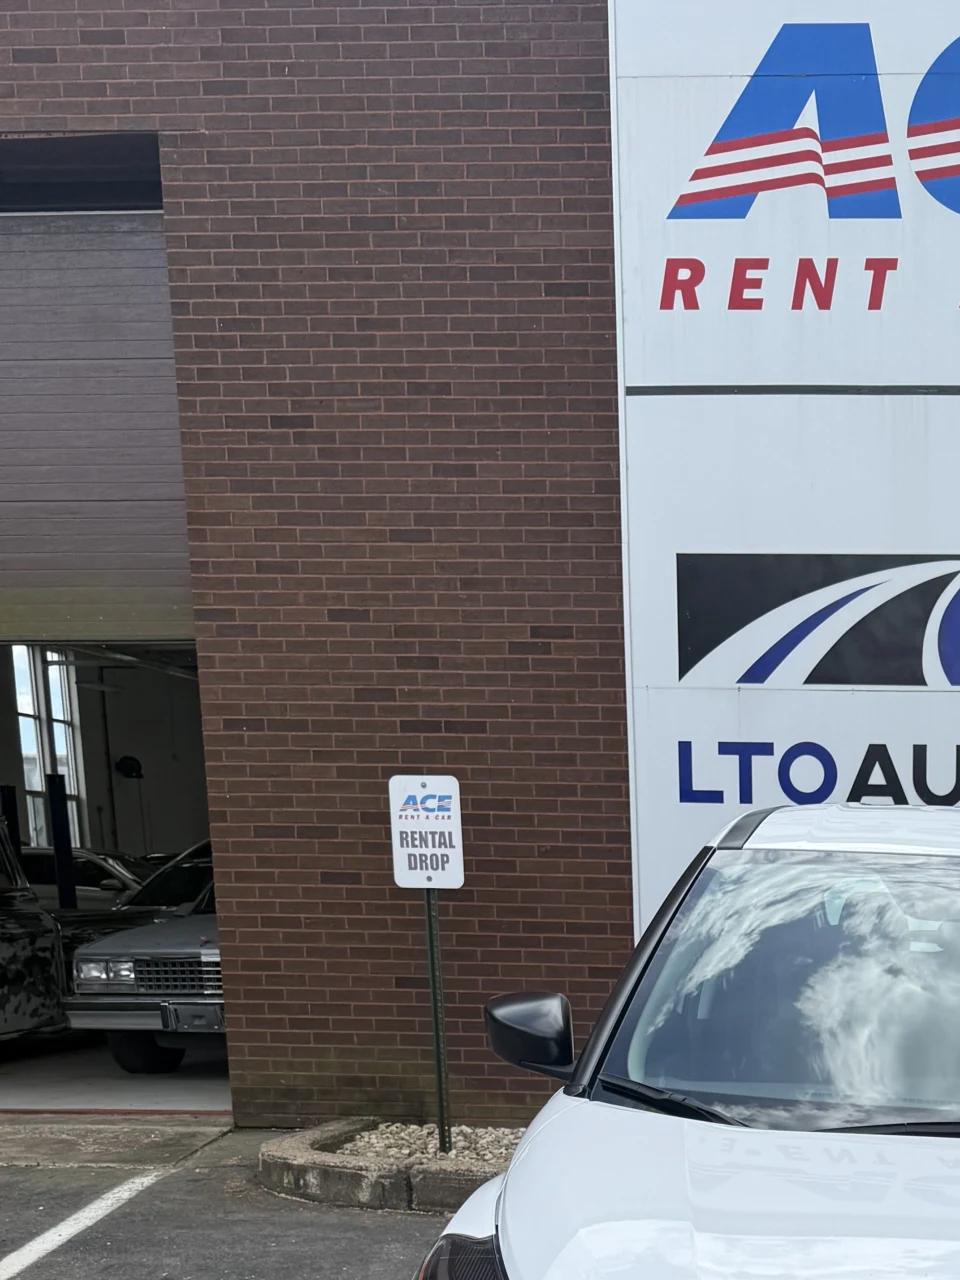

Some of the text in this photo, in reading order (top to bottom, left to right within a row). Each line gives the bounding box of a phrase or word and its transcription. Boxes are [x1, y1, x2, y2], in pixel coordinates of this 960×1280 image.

[659, 256, 899, 311] RENT
[399, 794, 453, 813] ACE
[399, 830, 456, 849] RENTAL
[407, 853, 450, 871] DROP
